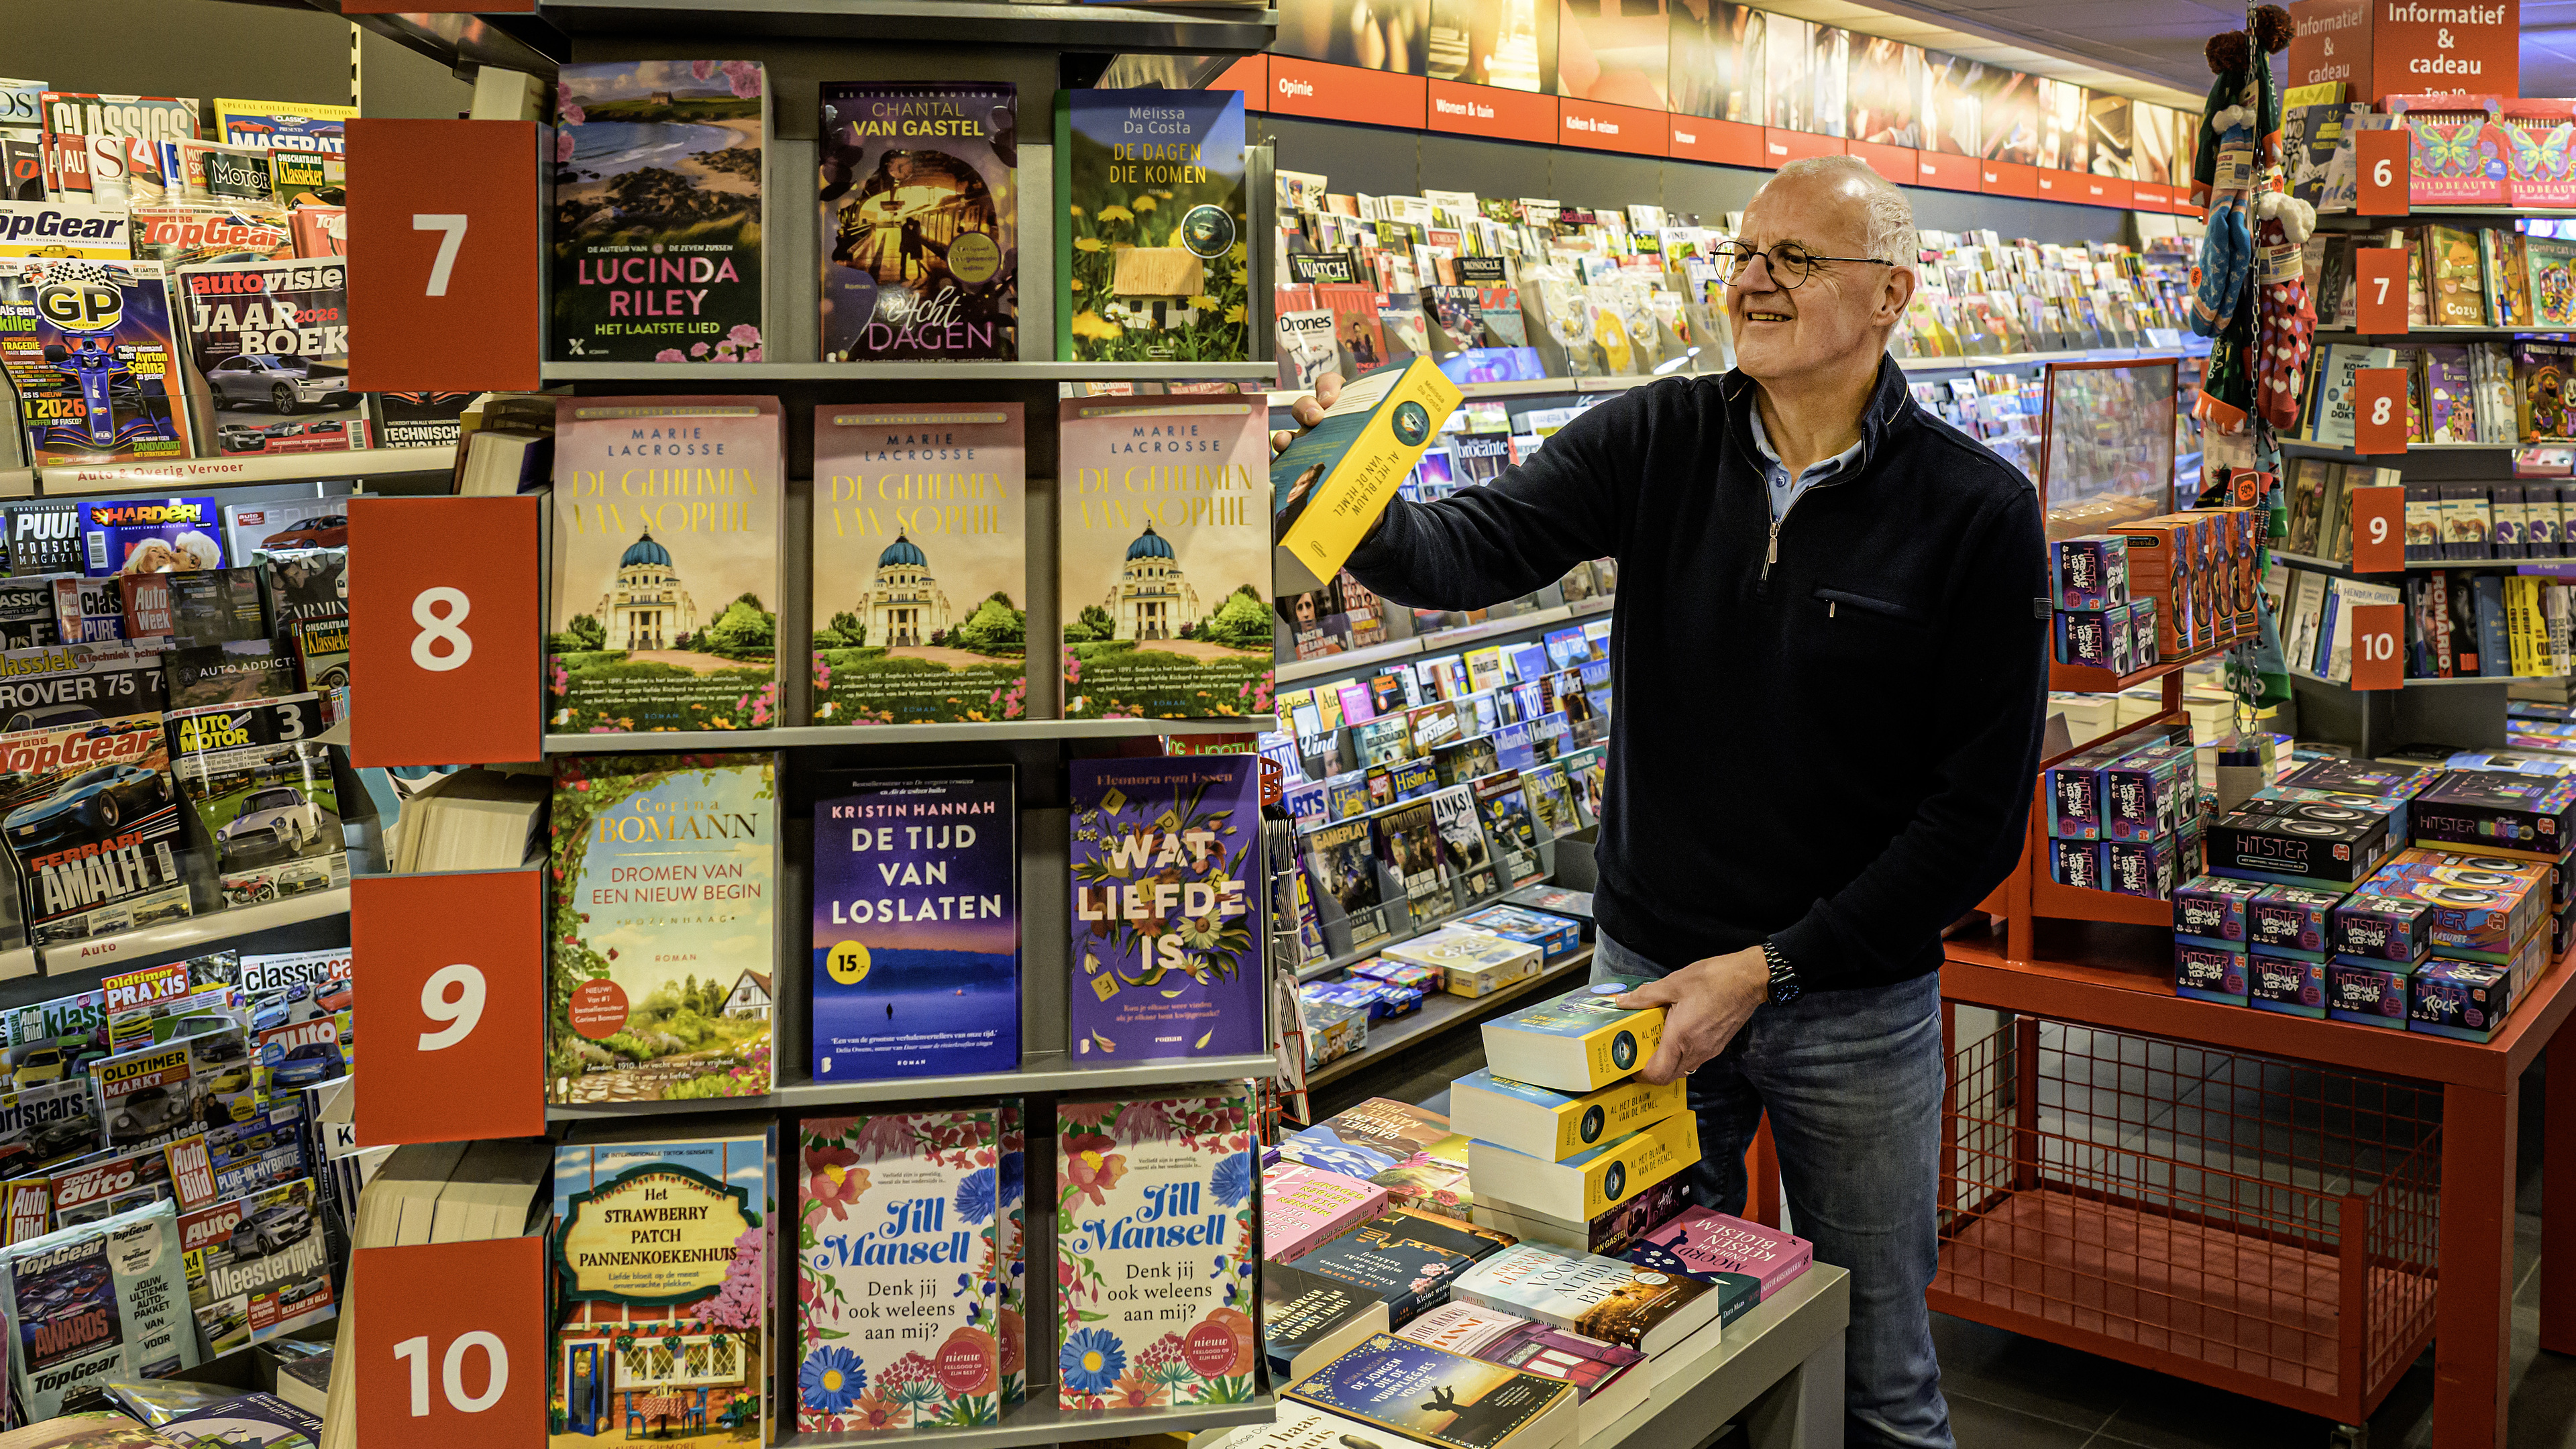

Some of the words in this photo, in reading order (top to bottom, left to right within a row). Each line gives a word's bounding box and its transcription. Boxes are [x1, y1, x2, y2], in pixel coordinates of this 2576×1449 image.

[2297, 5, 2363, 37] Informatief
[2389, 2, 2506, 25] Informatief
[2324, 36, 2334, 56] &
[2436, 28, 2455, 49] &
[2308, 62, 2350, 83] cadeau
[2410, 54, 2481, 74] cadeau
[1279, 78, 1313, 98] Opinie
[872, 102, 965, 117] CHANTAL
[1130, 106, 1185, 119] Mélissa
[1436, 99, 1466, 115] Wonen
[1467, 101, 1476, 116] &
[1477, 104, 1495, 119] tuin
[853, 120, 897, 136] VAN
[903, 119, 984, 136] GASTEL
[1124, 121, 1143, 133] Da
[1148, 121, 1191, 134] Costa
[277, 154, 322, 164] ONSCHATBARE
[1114, 143, 1135, 161] DE
[1142, 143, 1201, 161] DAGEN
[212, 160, 271, 189] MOTOR
[278, 161, 323, 186] Klassieker
[1110, 165, 1138, 183] DIE
[1145, 165, 1206, 183] KOMEN
[2373, 159, 2392, 187] 6
[142, 215, 286, 248] TopGear
[413, 214, 468, 297] 7
[1463, 260, 1501, 270] MONOCLE
[192, 267, 343, 294] autovisie
[579, 256, 739, 284] LUCINDA
[1298, 262, 1349, 278] WATCH
[610, 289, 708, 316] RILEY
[2373, 277, 2390, 305] 7
[40, 286, 121, 322] GP
[294, 307, 339, 323] 2026
[887, 284, 961, 331] Acht
[2447, 302, 2477, 319] Cozy
[192, 302, 299, 333] JAAR
[595, 323, 623, 335] HET
[626, 323, 684, 334] LAATSTE
[688, 322, 720, 333] LIED
[1280, 315, 1332, 332] Drones
[239, 325, 348, 356] BOEK
[868, 321, 992, 350] DAGEN
[126, 362, 166, 374] Senna
[136, 352, 168, 364] Ayrton
[2371, 396, 2392, 425] 8
[1133, 425, 1198, 437] MARIE
[1112, 440, 1220, 453] LACROSSE
[1387, 451, 1399, 465] AL
[1456, 440, 1508, 458] brocante
[78, 470, 113, 482] Auto
[134, 466, 184, 478] Overig
[187, 464, 244, 475] Vervoer
[1365, 455, 1384, 476] VAN
[1377, 464, 1391, 486] HET
[1124, 464, 1252, 492] GEHEIMEN
[1355, 475, 1369, 488] DE
[1332, 488, 1359, 517] HEMEL
[1352, 484, 1377, 516] BLAUW
[1081, 498, 1130, 529] VAN
[1142, 496, 1252, 527] SOPHIE
[2369, 517, 2387, 545] 9
[2343, 588, 2373, 599] HENDRIK
[2374, 591, 2396, 602] GROEN
[411, 586, 472, 672] 8
[2432, 575, 2451, 669] ROMARIO
[2361, 633, 2394, 661] 10
[0, 677, 97, 708] ROVER
[103, 673, 135, 696] 75
[180, 714, 232, 737] AUTO
[276, 704, 305, 741] 3
[180, 728, 250, 753] MOTOR
[1301, 729, 1338, 757] Vind
[636, 797, 719, 813] Corina
[832, 804, 907, 818] KRISTIN
[914, 801, 995, 816] HANNAH
[1291, 789, 1324, 818] BTS
[597, 812, 758, 843] BOMANN
[852, 827, 894, 851] DE
[905, 824, 977, 849] TIJD
[1311, 820, 1369, 846] GAMEPLAY
[2420, 816, 2475, 833] HITSTER
[2479, 821, 2534, 841] BINGO
[31, 830, 144, 872] FERRARI
[1111, 831, 1215, 869] WAT
[2237, 835, 2308, 859] HITSTER
[41, 844, 149, 915] AMALFI
[611, 865, 697, 883] DROMEN
[702, 863, 743, 879] VAN
[878, 861, 947, 886] VAN
[592, 889, 628, 904] EEN
[635, 885, 698, 903] NIEUW
[704, 883, 761, 900] BEGIN
[1078, 880, 1246, 921] LIEFDE
[832, 894, 1001, 924] LOSLATEN
[80, 943, 117, 958] Auto
[655, 954, 697, 963] ROMAN
[1141, 933, 1185, 970] IS
[106, 968, 173, 989] Oldtimer
[107, 974, 186, 1008] PRAXIS
[2416, 983, 2468, 1003] HITSTER
[417, 963, 486, 1051] 9
[2422, 995, 2459, 1014] ROCK
[103, 1048, 185, 1081] OLDTIMER
[106, 1073, 162, 1097] MARKT
[645, 1188, 668, 1201] Het
[604, 1205, 708, 1223] STRAWBERRY
[879, 1197, 945, 1239] Jill
[631, 1228, 681, 1244] PATCH
[1695, 1220, 1778, 1250] BLOESEM
[15, 1238, 104, 1277] TopGear
[579, 1246, 737, 1267] PANNENKOEKENHUIS
[813, 1231, 971, 1271] Mansell
[1678, 1247, 1748, 1272] MOORD
[1704, 1234, 1776, 1262] KERSEN
[210, 1236, 323, 1300] Meesterlijk!
[129, 1282, 168, 1303] ULTIEME
[134, 1275, 162, 1291] JOUW
[867, 1280, 913, 1297] Denk
[920, 1279, 937, 1299] jij
[133, 1301, 170, 1320] PAKKET
[849, 1301, 880, 1318] ook
[885, 1301, 955, 1318] weleens
[1285, 1314, 1324, 1340] AUDREY
[1323, 1299, 1352, 1316] JAMES
[35, 1308, 109, 1358] AWARDS
[865, 1328, 895, 1340] aan
[901, 1322, 938, 1342] mij?
[945, 1352, 980, 1363] nieuw
[393, 1330, 508, 1417] 10
[1350, 1378, 1369, 1391] DE
[1368, 1358, 1403, 1383] JONGEN
[1370, 1360, 1436, 1403] VUURVLIEGJES
[1373, 1375, 1394, 1389] DIE
[1391, 1367, 1408, 1379] DE
[1397, 1374, 1437, 1398] VOLGDE
